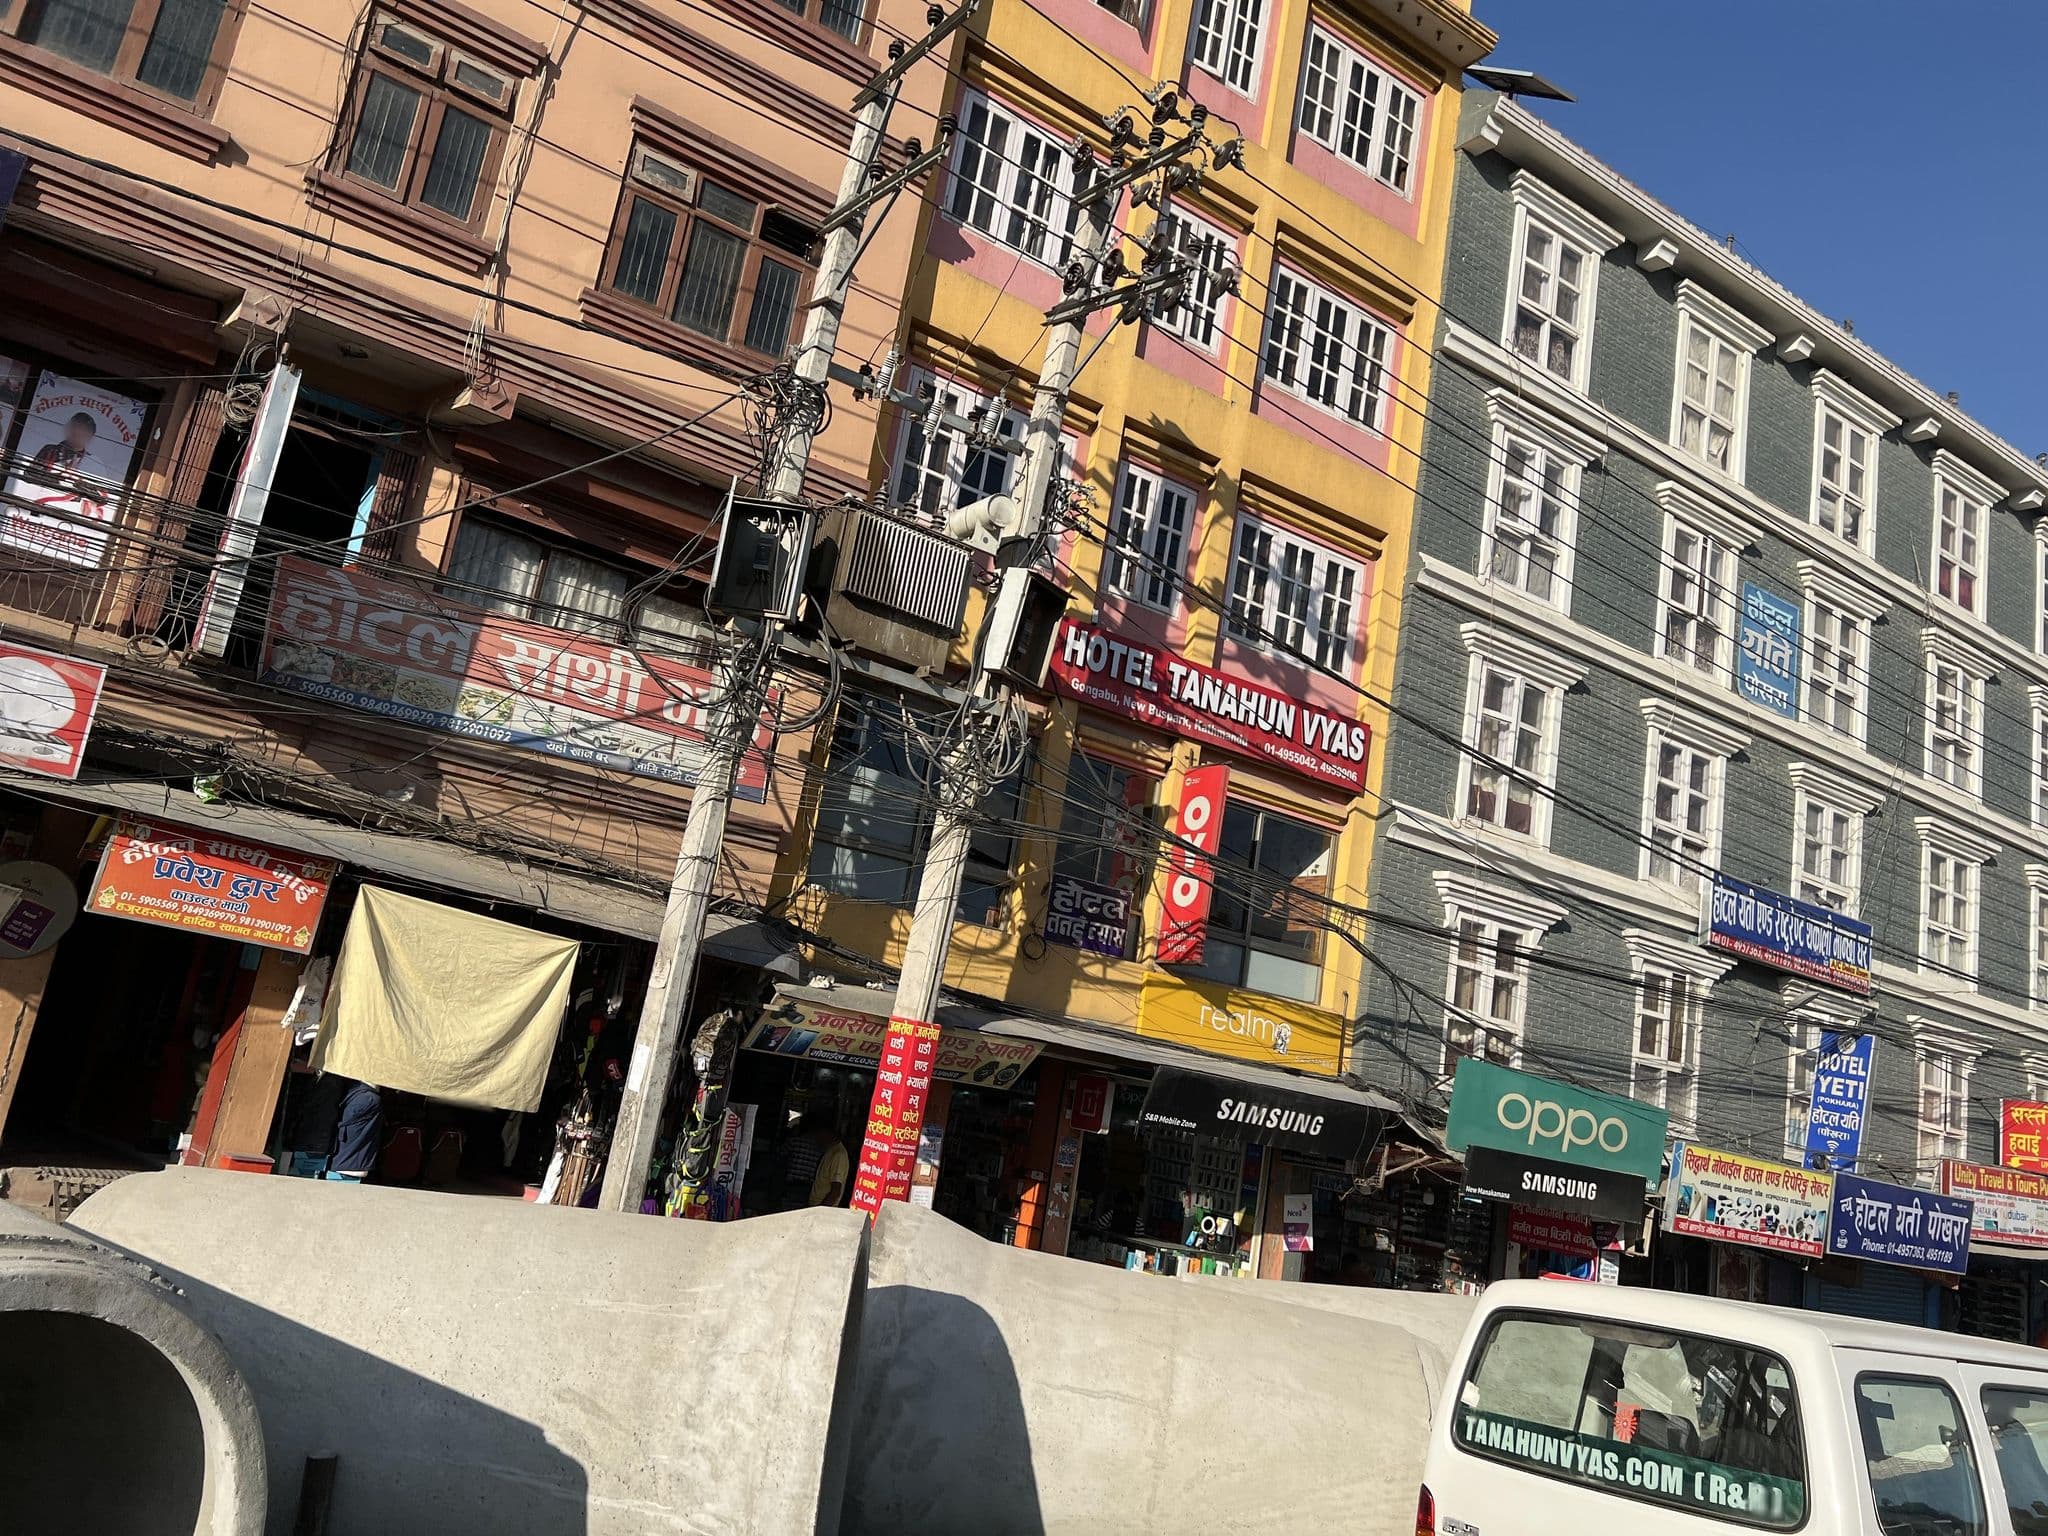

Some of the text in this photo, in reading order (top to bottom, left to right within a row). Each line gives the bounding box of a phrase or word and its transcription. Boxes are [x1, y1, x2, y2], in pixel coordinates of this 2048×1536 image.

[36, 395, 73, 414] होटल
[79, 394, 113, 419] साथी
[1748, 591, 1794, 636] होटल
[279, 568, 483, 675] होटल
[496, 631, 650, 722] साथी
[1742, 627, 1793, 679] यति
[1063, 625, 1367, 763] HOTEL TANAHUN VYAS
[1071, 677, 1121, 706] Gongabu,
[1123, 695, 1146, 713] New
[1148, 703, 1193, 730] Buspark,
[1172, 795, 1212, 908] OYO
[120, 837, 320, 905] होटल साथी भाई
[153, 855, 288, 904] प्रवेश द्वार
[137, 895, 180, 912] 5905569,
[239, 916, 293, 935] 9813901092
[1053, 879, 1127, 922] होटल
[1713, 877, 1738, 926] होटल
[808, 1010, 885, 1038] जनसेवा
[888, 1020, 914, 1036] जनसेवा
[915, 1025, 940, 1041] जनसेवा
[1200, 1005, 1292, 1041] realme
[1819, 1053, 1867, 1076] HOTEL
[1817, 1075, 1865, 1100] YETI
[1817, 1096, 1859, 1110] (POKHARA)
[875, 1103, 893, 1118] फोटो
[902, 1109, 919, 1123] फोटो
[1159, 1114, 1181, 1127] Mobile
[1181, 1118, 1197, 1129] Zone
[1216, 1098, 1325, 1136] SAMSUNG
[1497, 1092, 1628, 1153] oppo
[1811, 1105, 1840, 1128] होटल
[2009, 1131, 2042, 1156] हवाई
[1521, 1171, 1598, 1200] SAMSUNG
[1743, 1165, 1764, 1184] हाउस
[1955, 1163, 1977, 1190] Unity
[1978, 1168, 2004, 1189] Travel
[2005, 1174, 2015, 1189] &
[2014, 1175, 2039, 1194] Tours
[1465, 1185, 1511, 1199] New Manakamana
[1855, 1189, 1892, 1236] होटल
[1895, 1196, 1923, 1239] यती
[1927, 1202, 1969, 1250] पोखरा
[1861, 1238, 1887, 1254] Phone:
[1464, 1417, 1684, 1496] TANAHUNVYAS.COM
